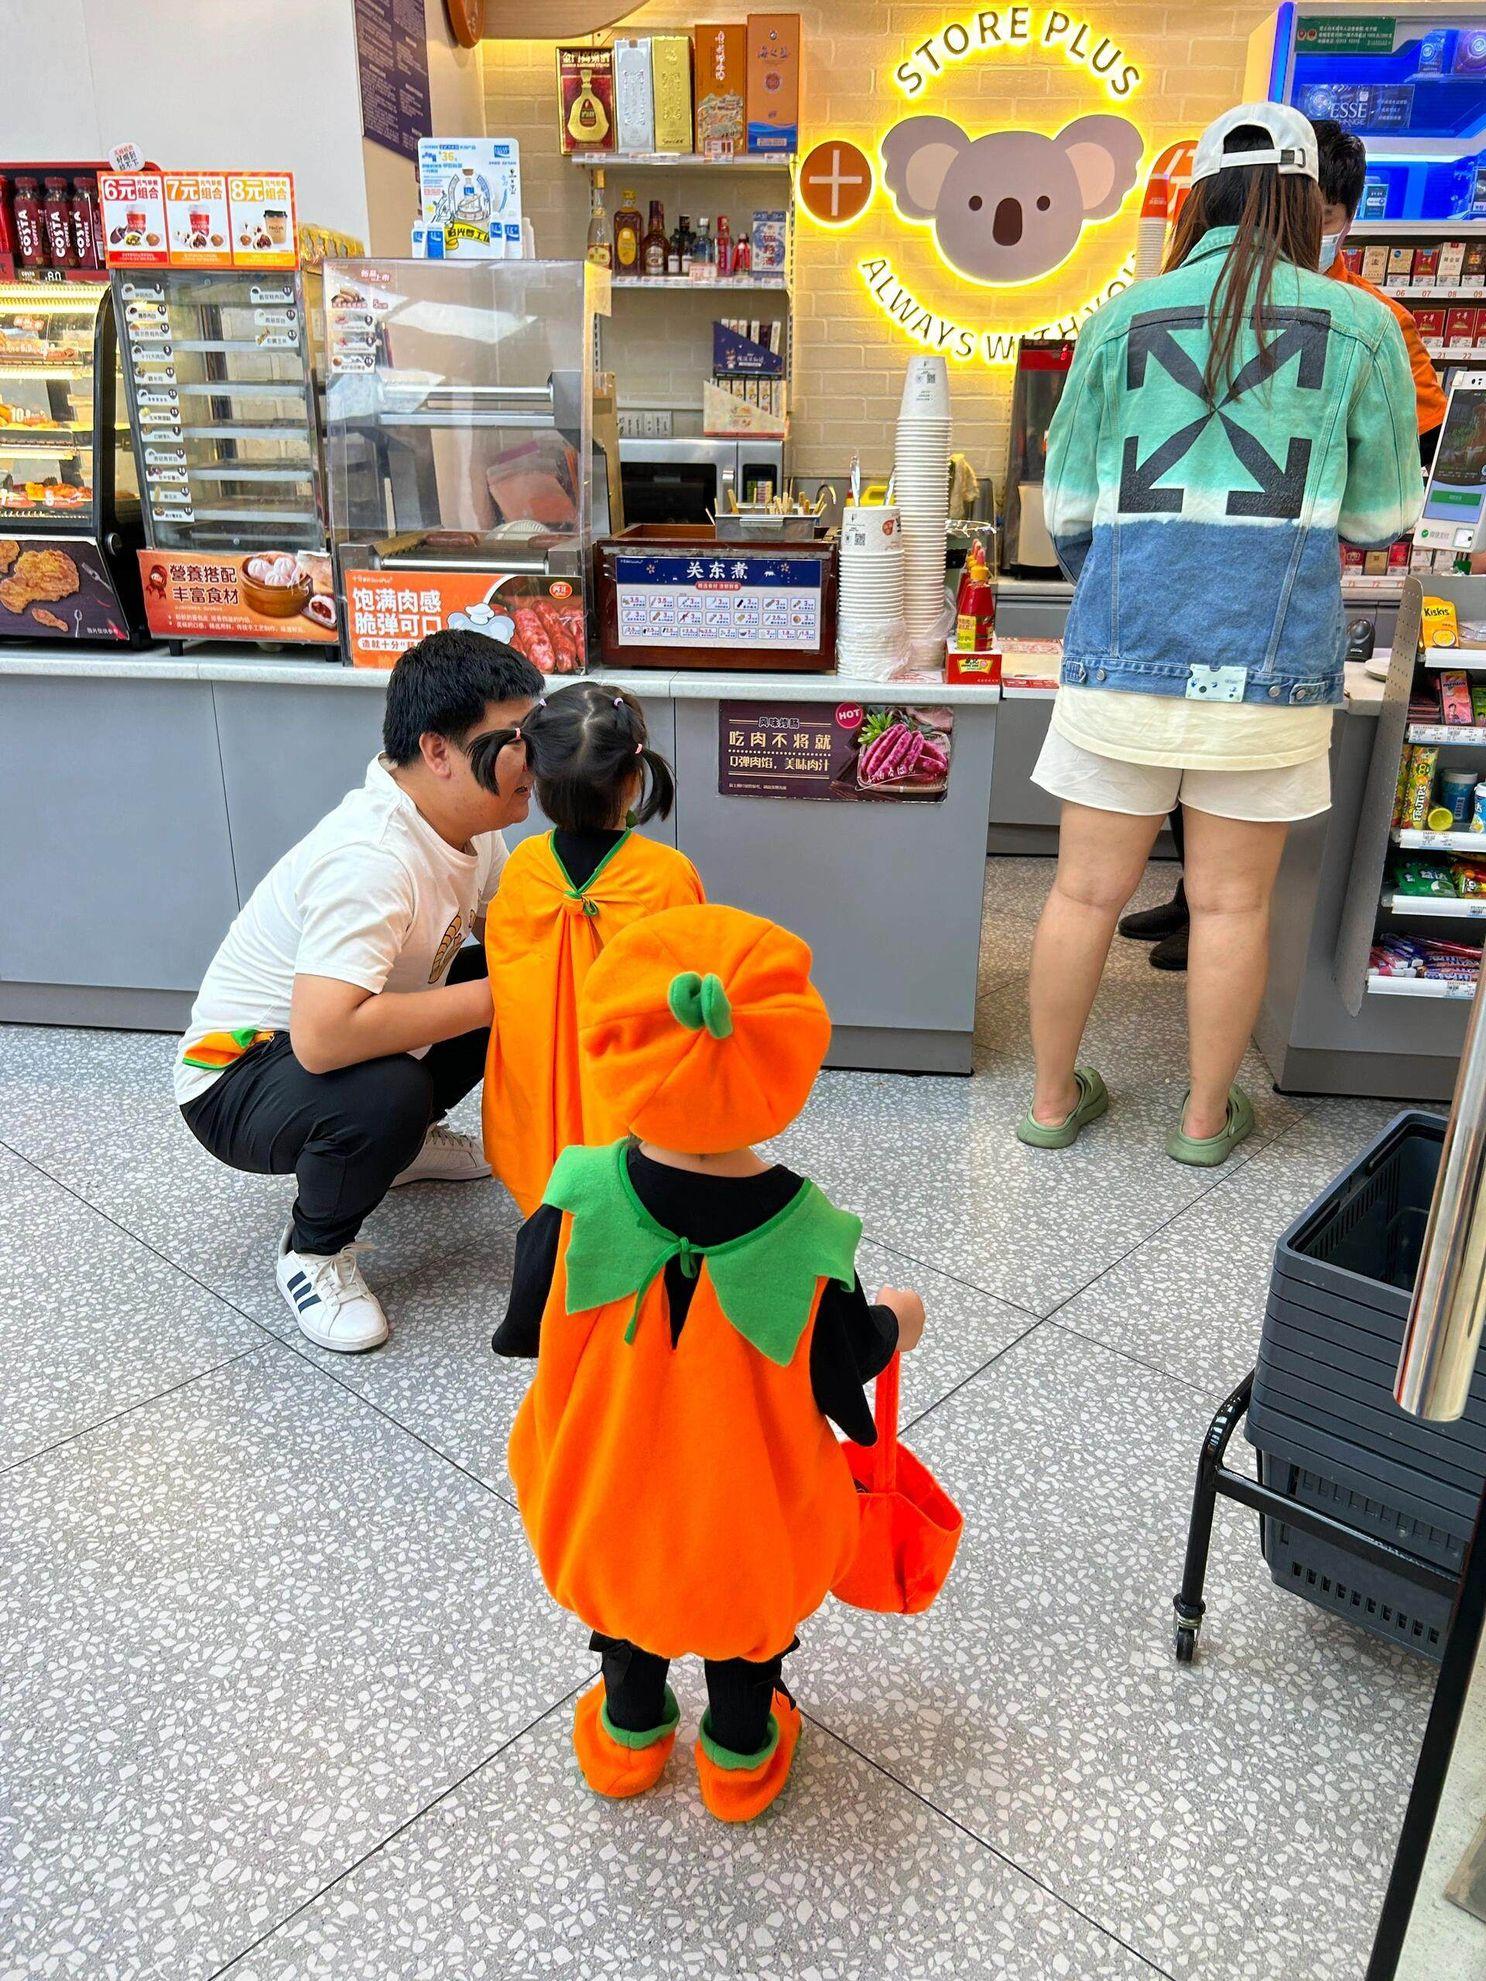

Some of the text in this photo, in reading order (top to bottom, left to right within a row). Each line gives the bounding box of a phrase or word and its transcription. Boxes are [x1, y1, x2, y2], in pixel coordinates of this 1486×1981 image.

[897, 8, 1139, 95] STORE PLUS
[1330, 103, 1368, 118] ESSE
[104, 180, 136, 200] 6元
[166, 180, 199, 200] 7元
[231, 180, 263, 201] 8元
[18, 209, 33, 256] COSTA
[50, 211, 66, 258] COSTA
[73, 211, 86, 258] COSTA
[862, 259, 976, 358] ALWAYS
[686, 561, 749, 579] 关东煮
[172, 586, 239, 604] 丰富食材
[353, 587, 442, 613] 饱满肉感
[355, 612, 442, 637] 脆弹可口
[838, 709, 860, 720] HOT
[729, 731, 832, 750] 吃肉不将就
